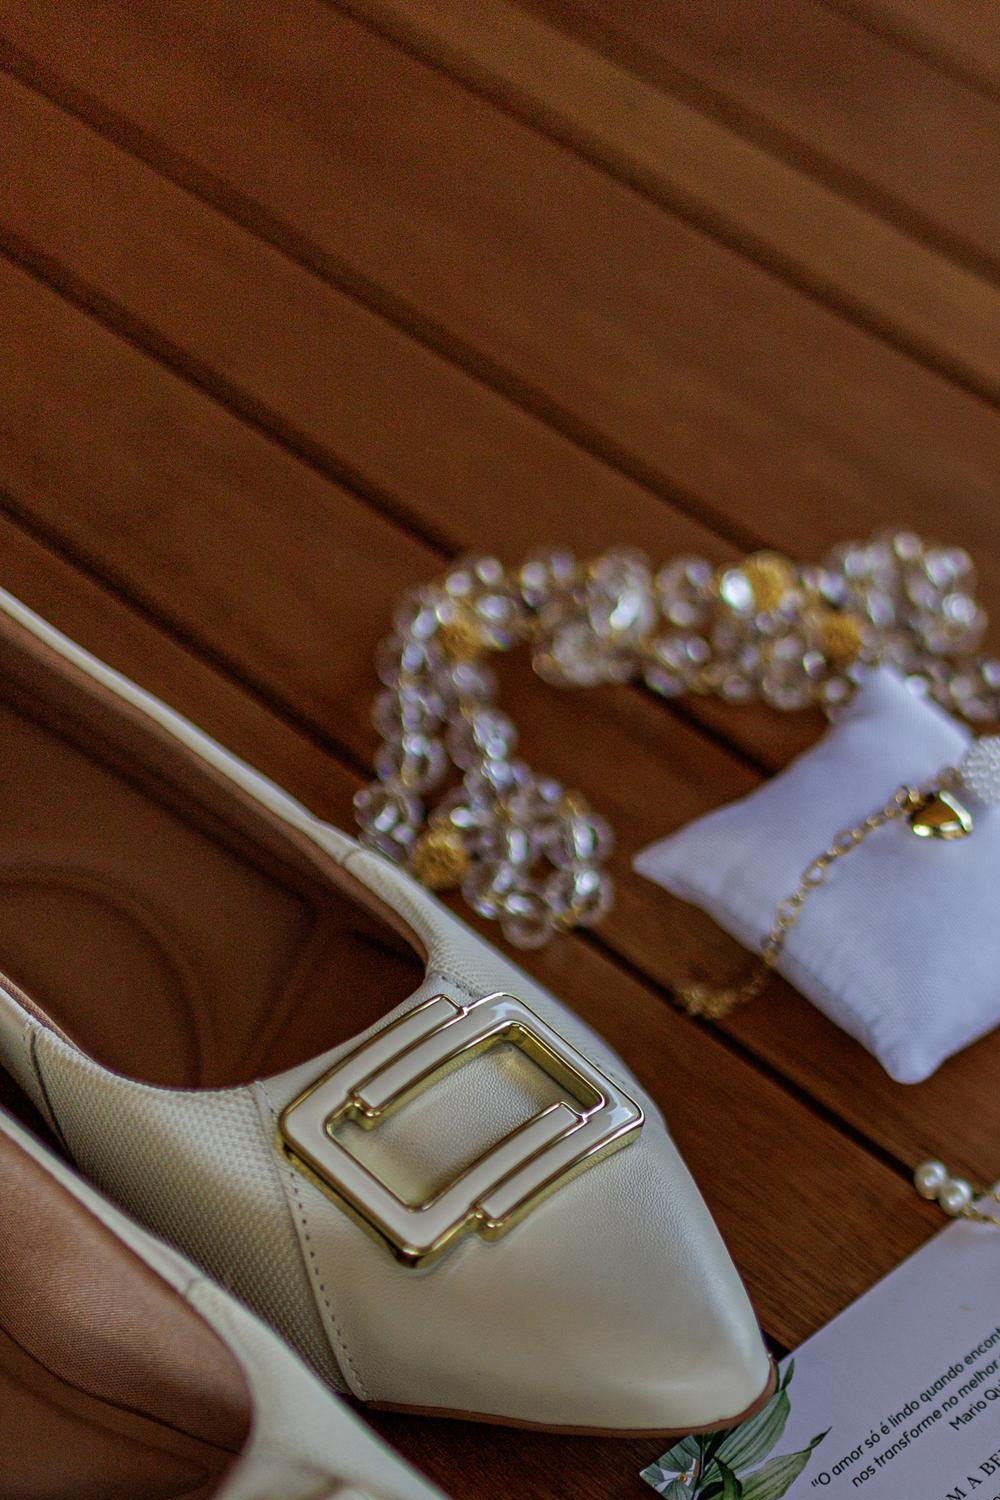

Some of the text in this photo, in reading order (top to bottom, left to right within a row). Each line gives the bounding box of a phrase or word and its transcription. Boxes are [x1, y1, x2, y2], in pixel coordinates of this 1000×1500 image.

[830, 1443, 864, 1476] amor
[863, 1428, 881, 1449] só
[878, 1420, 891, 1435] é
[886, 1399, 921, 1428] lindo
[918, 1362, 965, 1403] quando
[850, 1464, 877, 1488] nos
[872, 1408, 943, 1468] transforme
[940, 1394, 959, 1413] no
[956, 1358, 999, 1399] melhor
[947, 1399, 988, 1431] Mario
[965, 1475, 983, 1490] A
